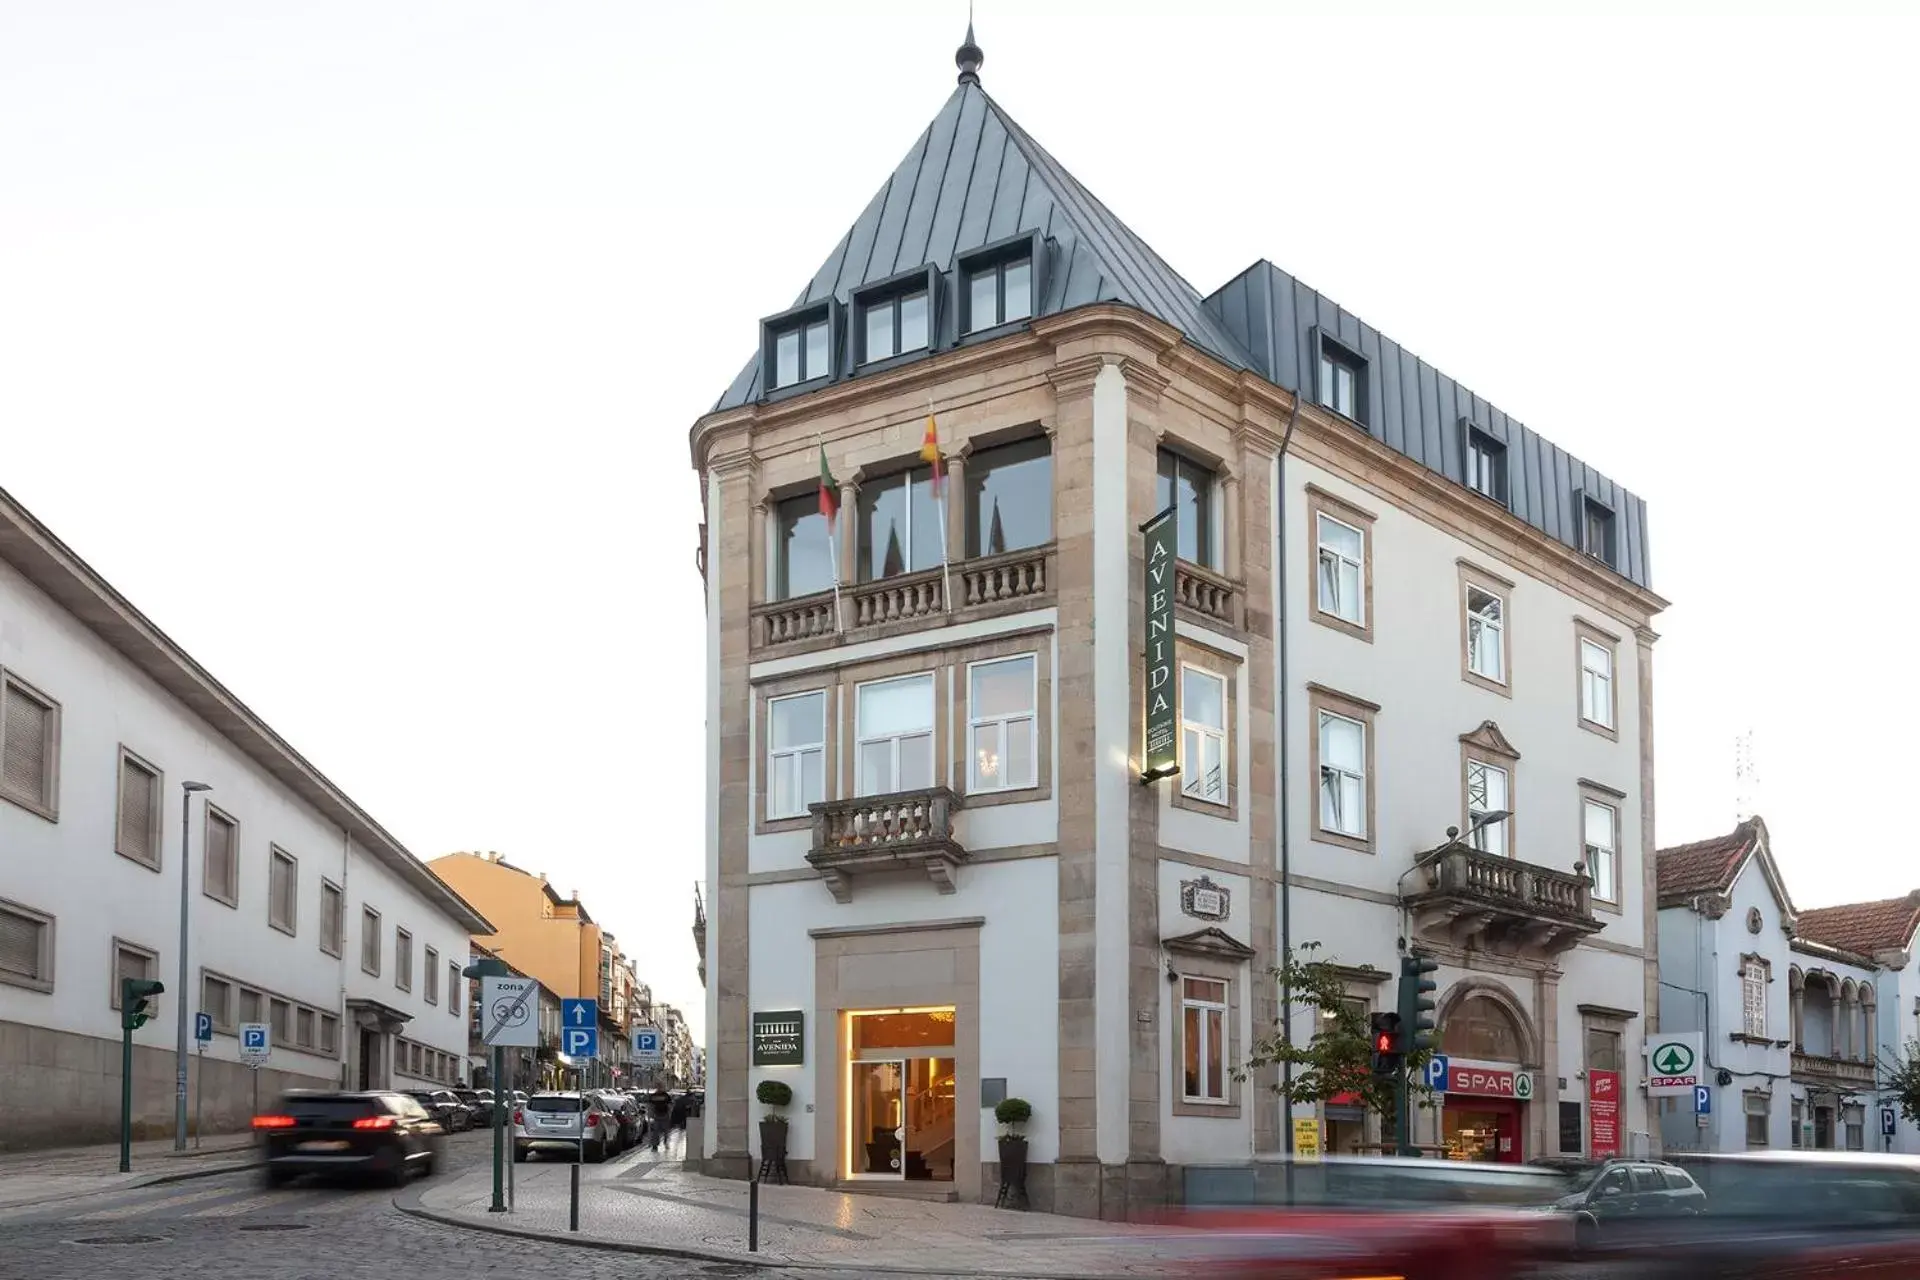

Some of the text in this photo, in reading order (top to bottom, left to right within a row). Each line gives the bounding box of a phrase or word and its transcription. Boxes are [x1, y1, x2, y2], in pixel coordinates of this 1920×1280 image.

[1149, 540, 1169, 716] AVENIDA
[497, 983, 524, 991] zona
[496, 1004, 525, 1019] 30
[199, 1016, 208, 1036] P
[248, 1032, 261, 1046] P
[570, 1031, 590, 1055] P
[641, 1035, 652, 1049] P
[757, 1043, 798, 1051] AVENIDA
[1429, 1058, 1443, 1086] P
[1456, 1072, 1512, 1092] SPAR
[1652, 1077, 1695, 1086] SPAR
[1697, 1088, 1708, 1111] P
[1884, 1110, 1893, 1133] P
